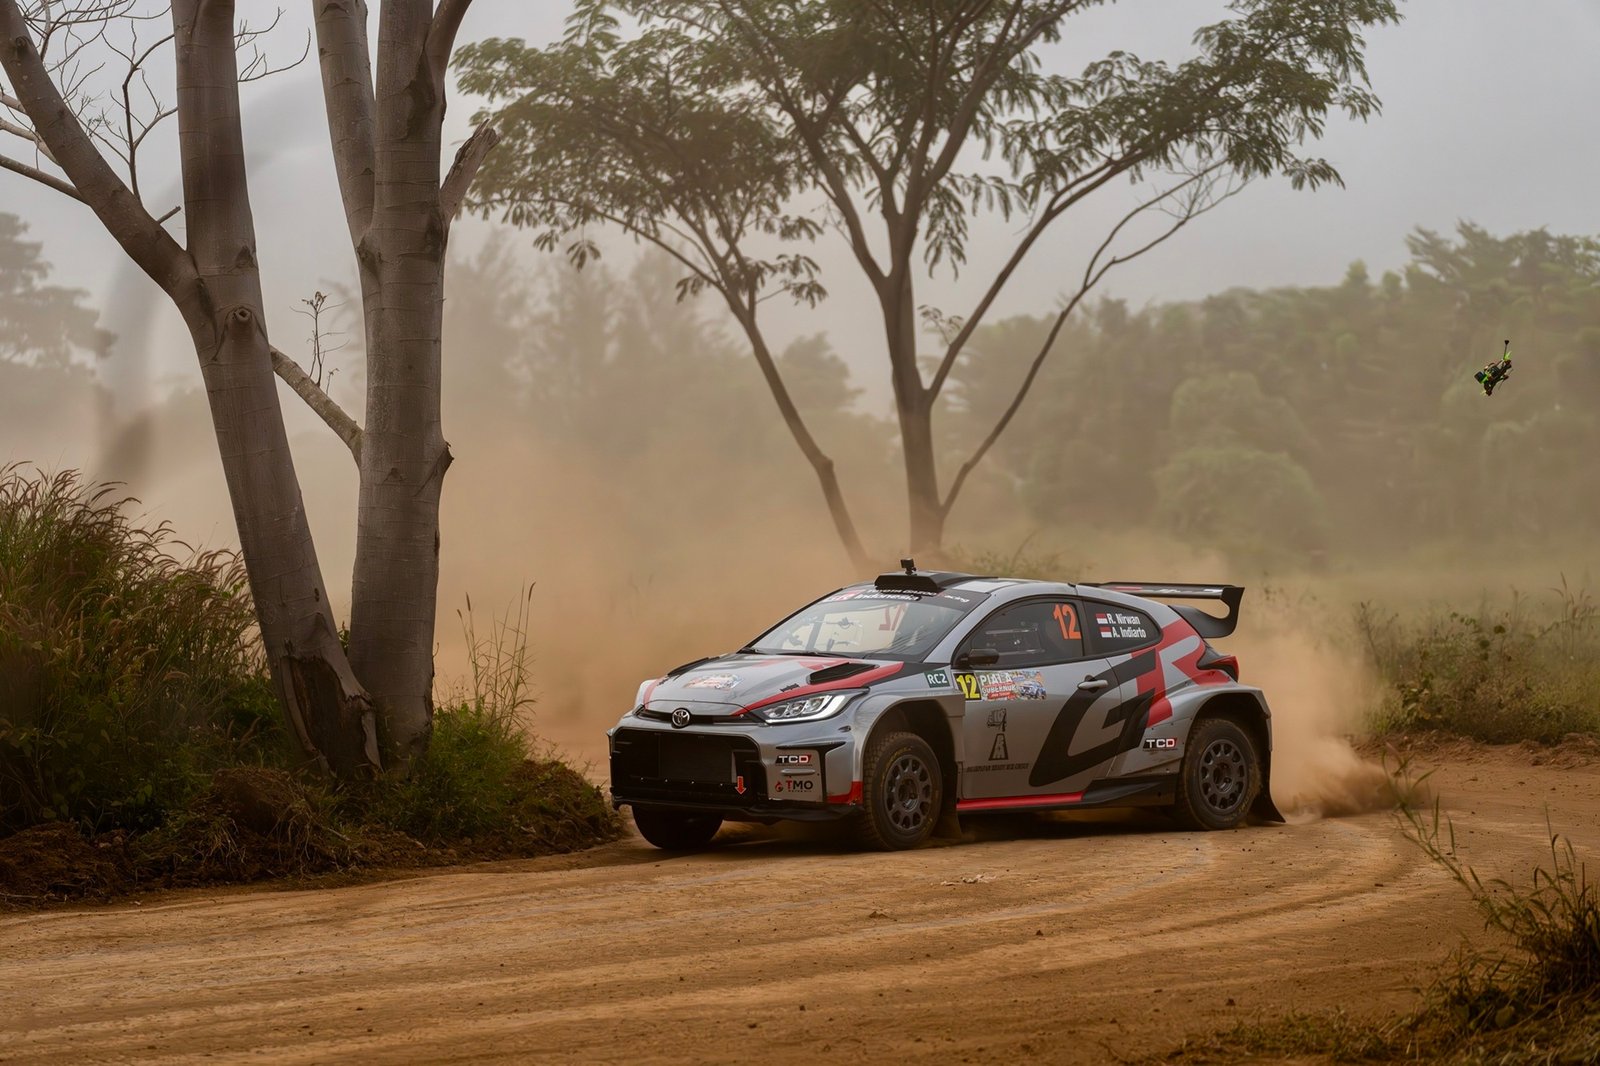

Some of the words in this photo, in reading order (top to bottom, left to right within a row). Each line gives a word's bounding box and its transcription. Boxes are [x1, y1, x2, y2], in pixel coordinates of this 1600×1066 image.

[1053, 603, 1081, 640] 12
[1106, 613, 1116, 624] R.
[1116, 613, 1141, 625] Nirwan
[1112, 627, 1120, 638] A.
[1120, 627, 1147, 638] Indiarto
[927, 673, 948, 685] RC2
[956, 674, 980, 699] 12
[1146, 738, 1175, 748] TCD
[778, 755, 809, 764] TCD
[786, 780, 813, 790] TMO
